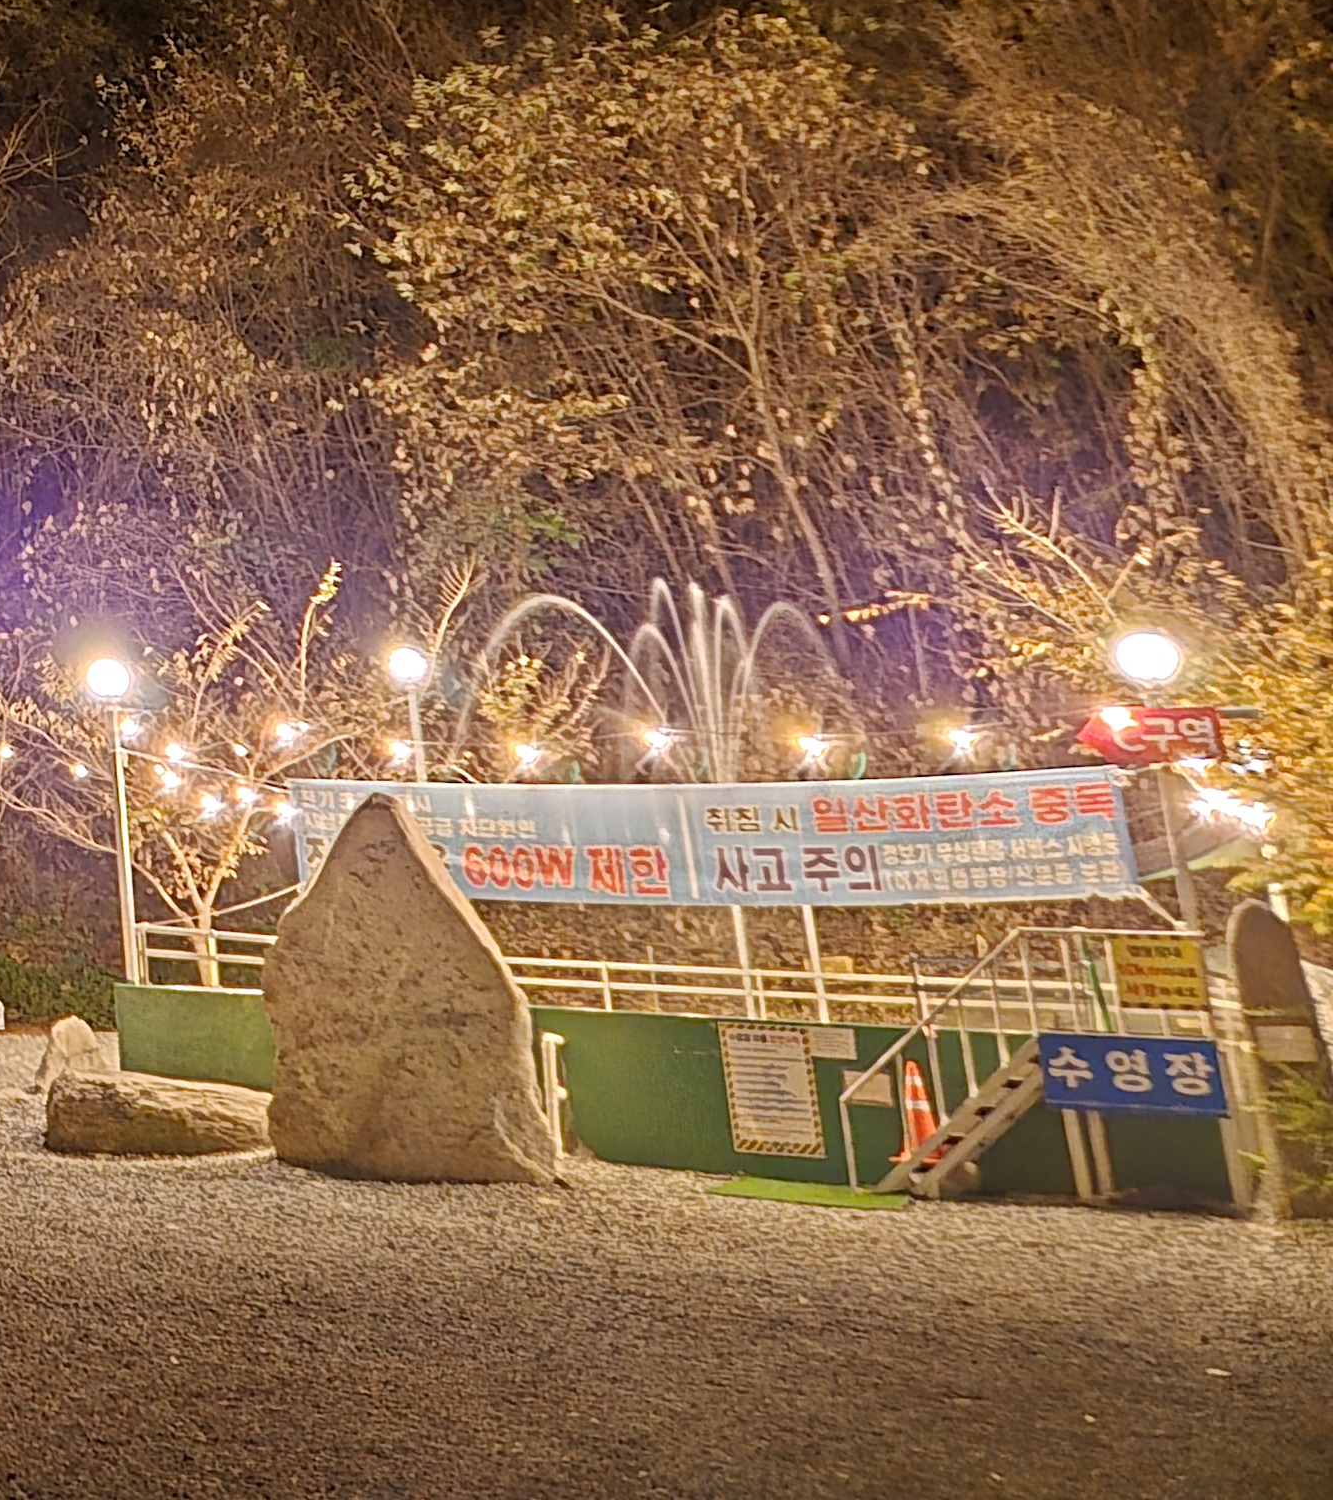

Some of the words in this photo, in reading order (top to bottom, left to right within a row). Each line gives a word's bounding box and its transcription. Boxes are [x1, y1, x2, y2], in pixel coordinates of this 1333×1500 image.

[703, 805, 763, 834] 취침
[771, 805, 800, 833] 시
[810, 790, 1022, 833] 일산화탄소
[1026, 781, 1115, 827] 중독
[461, 843, 576, 891] 600W
[583, 843, 671, 898] 제한
[715, 843, 792, 893] 사고
[802, 842, 883, 892] 주의
[1047, 1046, 1216, 1097] 수영장
